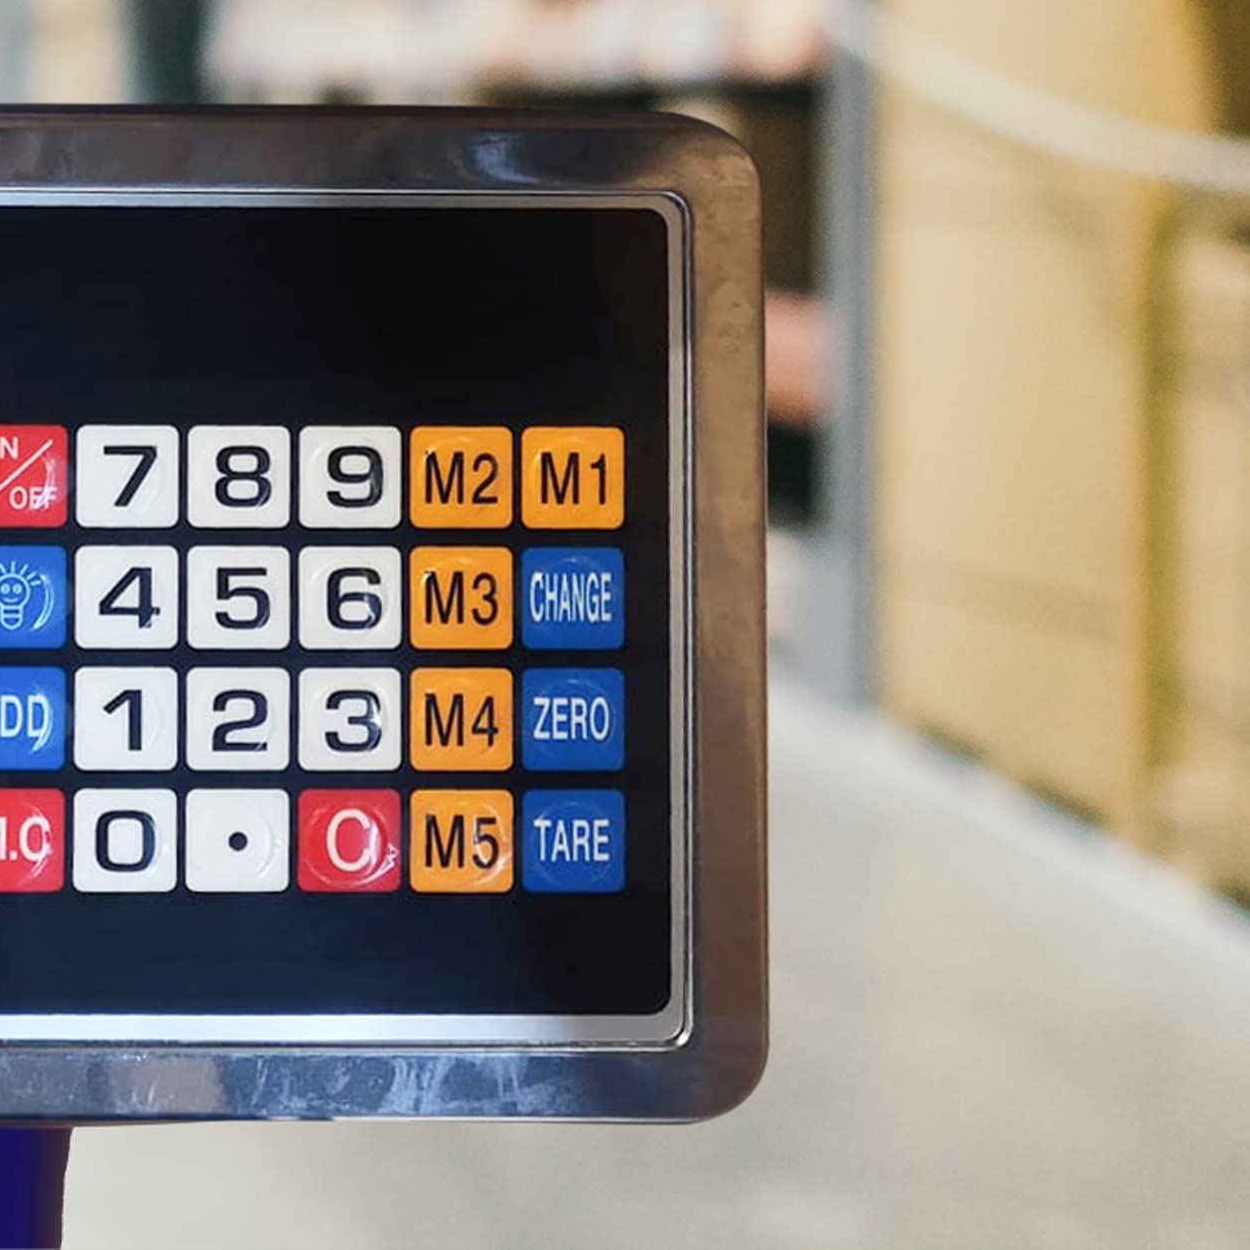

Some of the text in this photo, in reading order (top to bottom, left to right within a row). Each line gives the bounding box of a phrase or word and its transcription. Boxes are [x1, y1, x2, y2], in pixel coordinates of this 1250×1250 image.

[9, 487, 58, 510] OFF
[103, 445, 157, 507] 7
[214, 445, 272, 508] 8
[325, 445, 383, 508] 9
[424, 451, 499, 505] M2
[540, 451, 607, 505] M1
[99, 566, 161, 629] 4
[214, 567, 272, 629] 5
[325, 567, 383, 629] 6
[424, 571, 499, 625] M3
[530, 571, 611, 623] CHANGE
[103, 689, 142, 751] 1
[212, 689, 268, 751] 2
[324, 689, 383, 752] 3
[424, 693, 498, 747] M4
[533, 697, 609, 741] ZERO
[327, 809, 378, 869] C
[424, 814, 498, 868] M5
[534, 818, 609, 861] TARE
